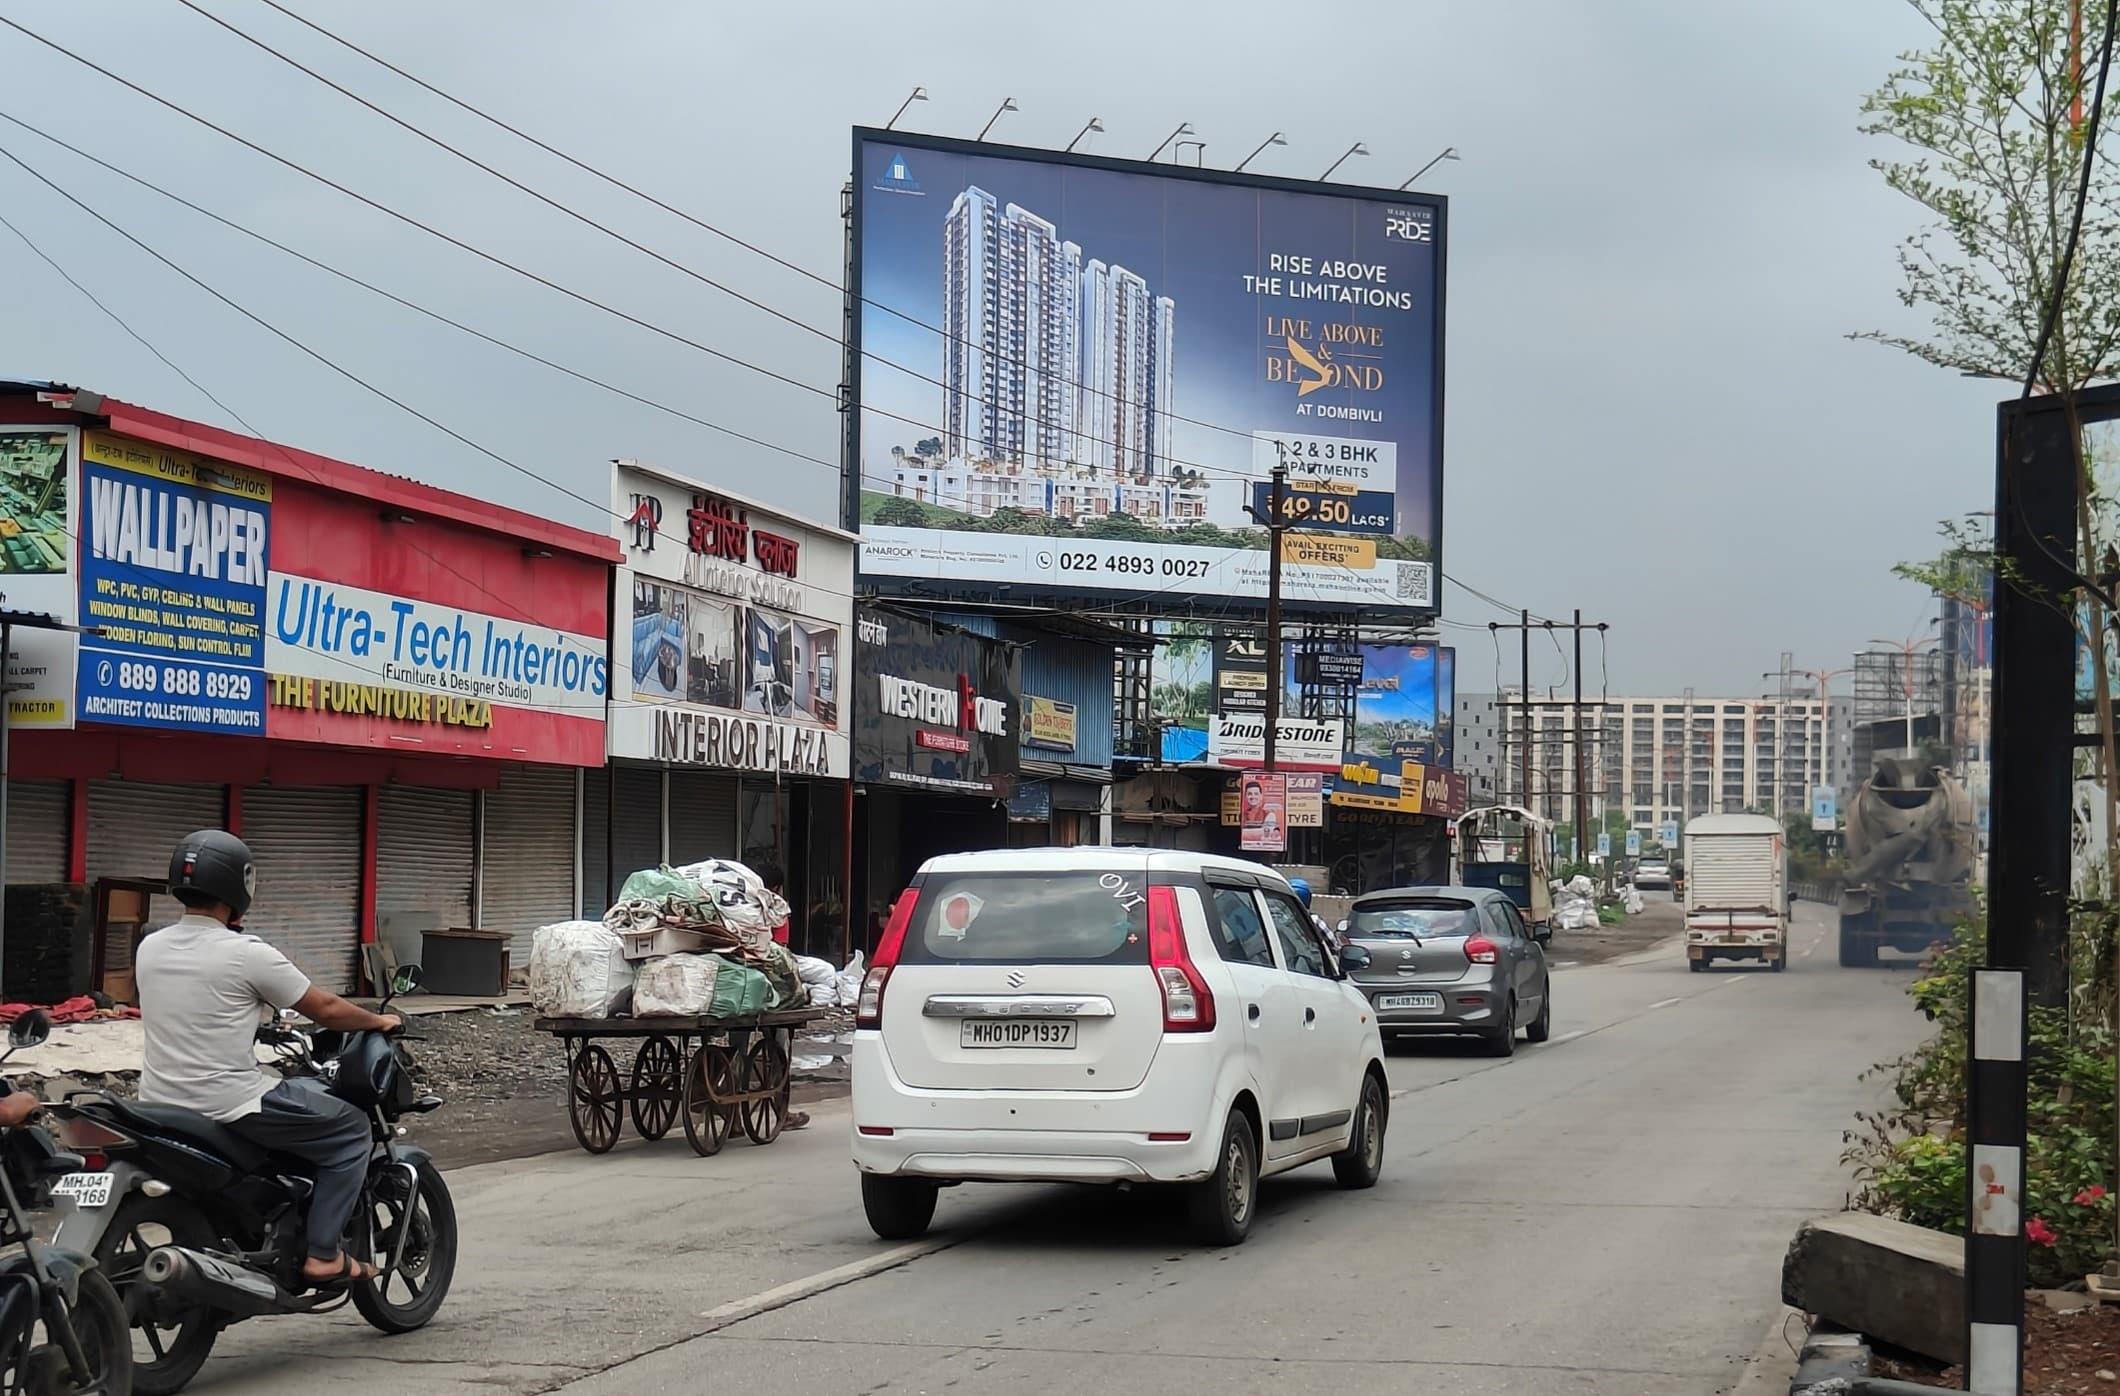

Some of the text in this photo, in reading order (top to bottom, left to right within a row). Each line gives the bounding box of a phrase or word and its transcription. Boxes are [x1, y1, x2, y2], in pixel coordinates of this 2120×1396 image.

[1386, 217, 1432, 241] PRIDE
[1270, 253, 1388, 284] RISE ABOVE
[1243, 275, 1412, 310] THE LIMITATIONS
[1267, 316, 1384, 347] LIVE ABOVE
[1317, 343, 1332, 361] &
[1296, 403, 1383, 423] AT DOMBIVLI
[1293, 441, 1302, 456] 2
[1308, 442, 1319, 457] &
[1325, 443, 1335, 459] 3
[1341, 445, 1378, 463] BHK
[91, 475, 266, 587] WALLPAPER
[1287, 540, 1359, 554] AVAIL EXCITING
[865, 545, 913, 558] ANAROCK
[1060, 552, 1210, 578] 022 4893 0027
[97, 578, 119, 599] WPC,
[121, 582, 140, 602] PVC,
[162, 590, 194, 608] CEILING
[204, 596, 225, 613] WALL
[227, 600, 256, 616] PANELS
[683, 553, 802, 612] All Interior Solution
[89, 600, 126, 618] WINDOW
[128, 606, 160, 627] BLINDS,
[163, 611, 185, 628] WALL
[187, 615, 229, 636] COVERING,
[137, 631, 177, 653] FLORING,
[178, 635, 196, 651] SUN
[197, 638, 233, 655] CONTROL
[277, 579, 607, 696] Ultra-Tech Interiors
[1225, 640, 1266, 656] XL
[119, 662, 251, 700] 889 888 8929
[382, 663, 532, 704] (Furniture & Designer Studio)
[85, 695, 260, 728] ARCHITECT COLLECTIONS PRODUCTS
[272, 674, 494, 728] THE FURNITURE PLAZA
[879, 674, 959, 728] WESTERN
[654, 709, 830, 775] INTERIOR PLAZA
[973, 1024, 1071, 1042] MH01DP1937
